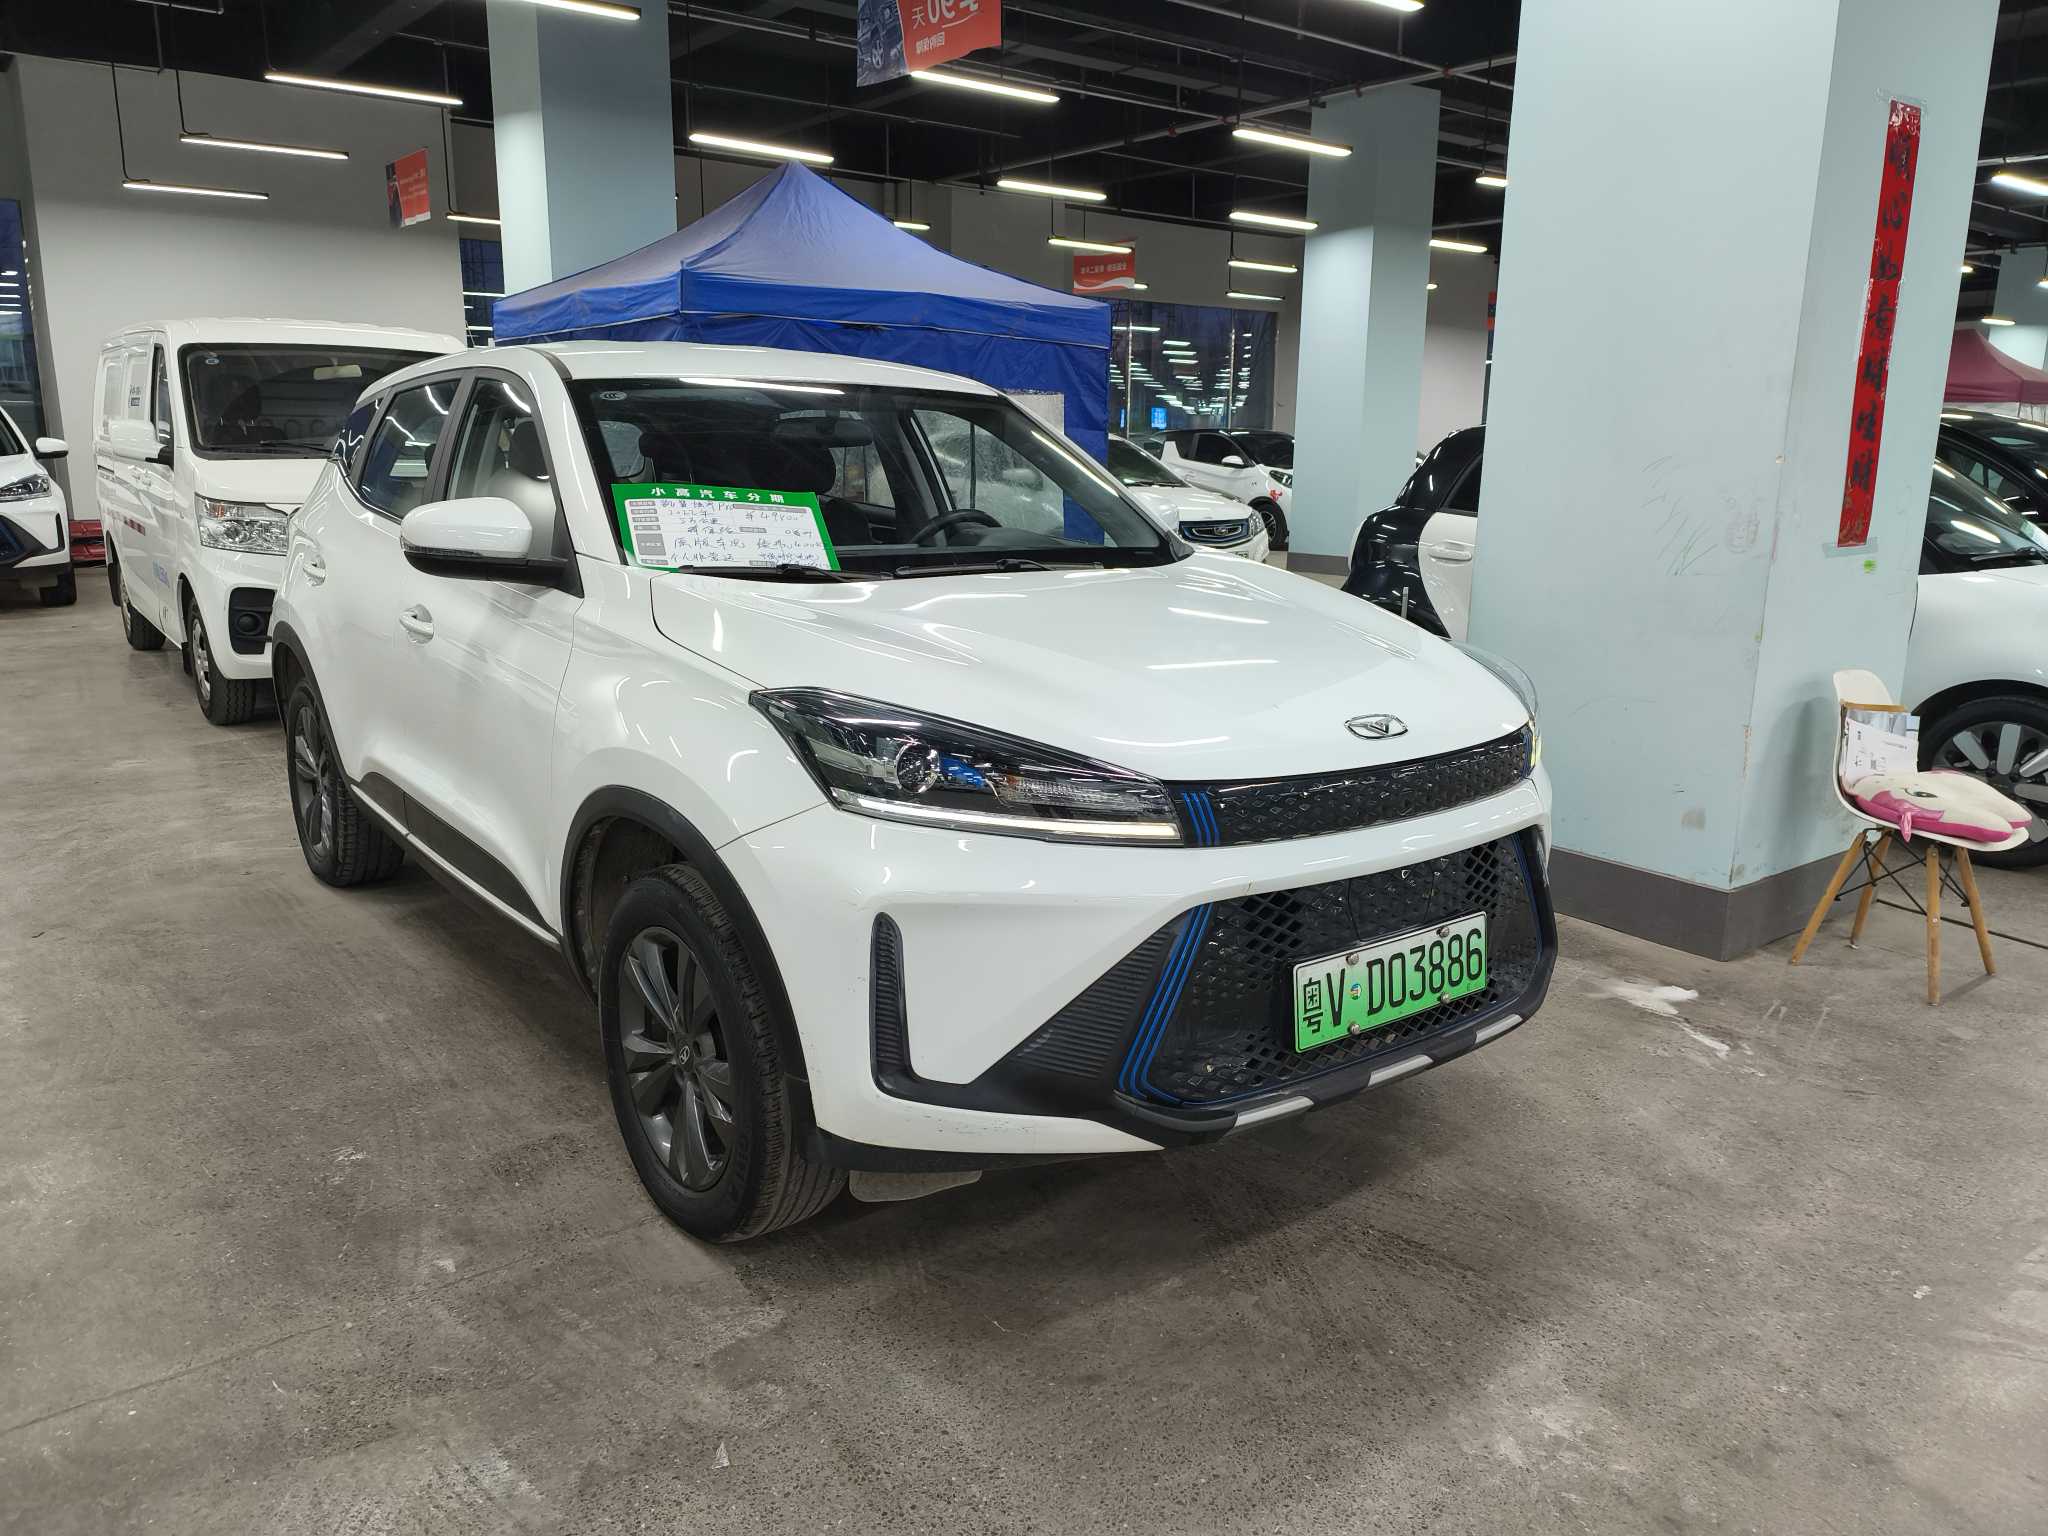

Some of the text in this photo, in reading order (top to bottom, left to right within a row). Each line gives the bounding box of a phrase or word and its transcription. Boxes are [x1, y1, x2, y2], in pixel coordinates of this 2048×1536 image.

[651, 487, 785, 504] 小高汽车分期
